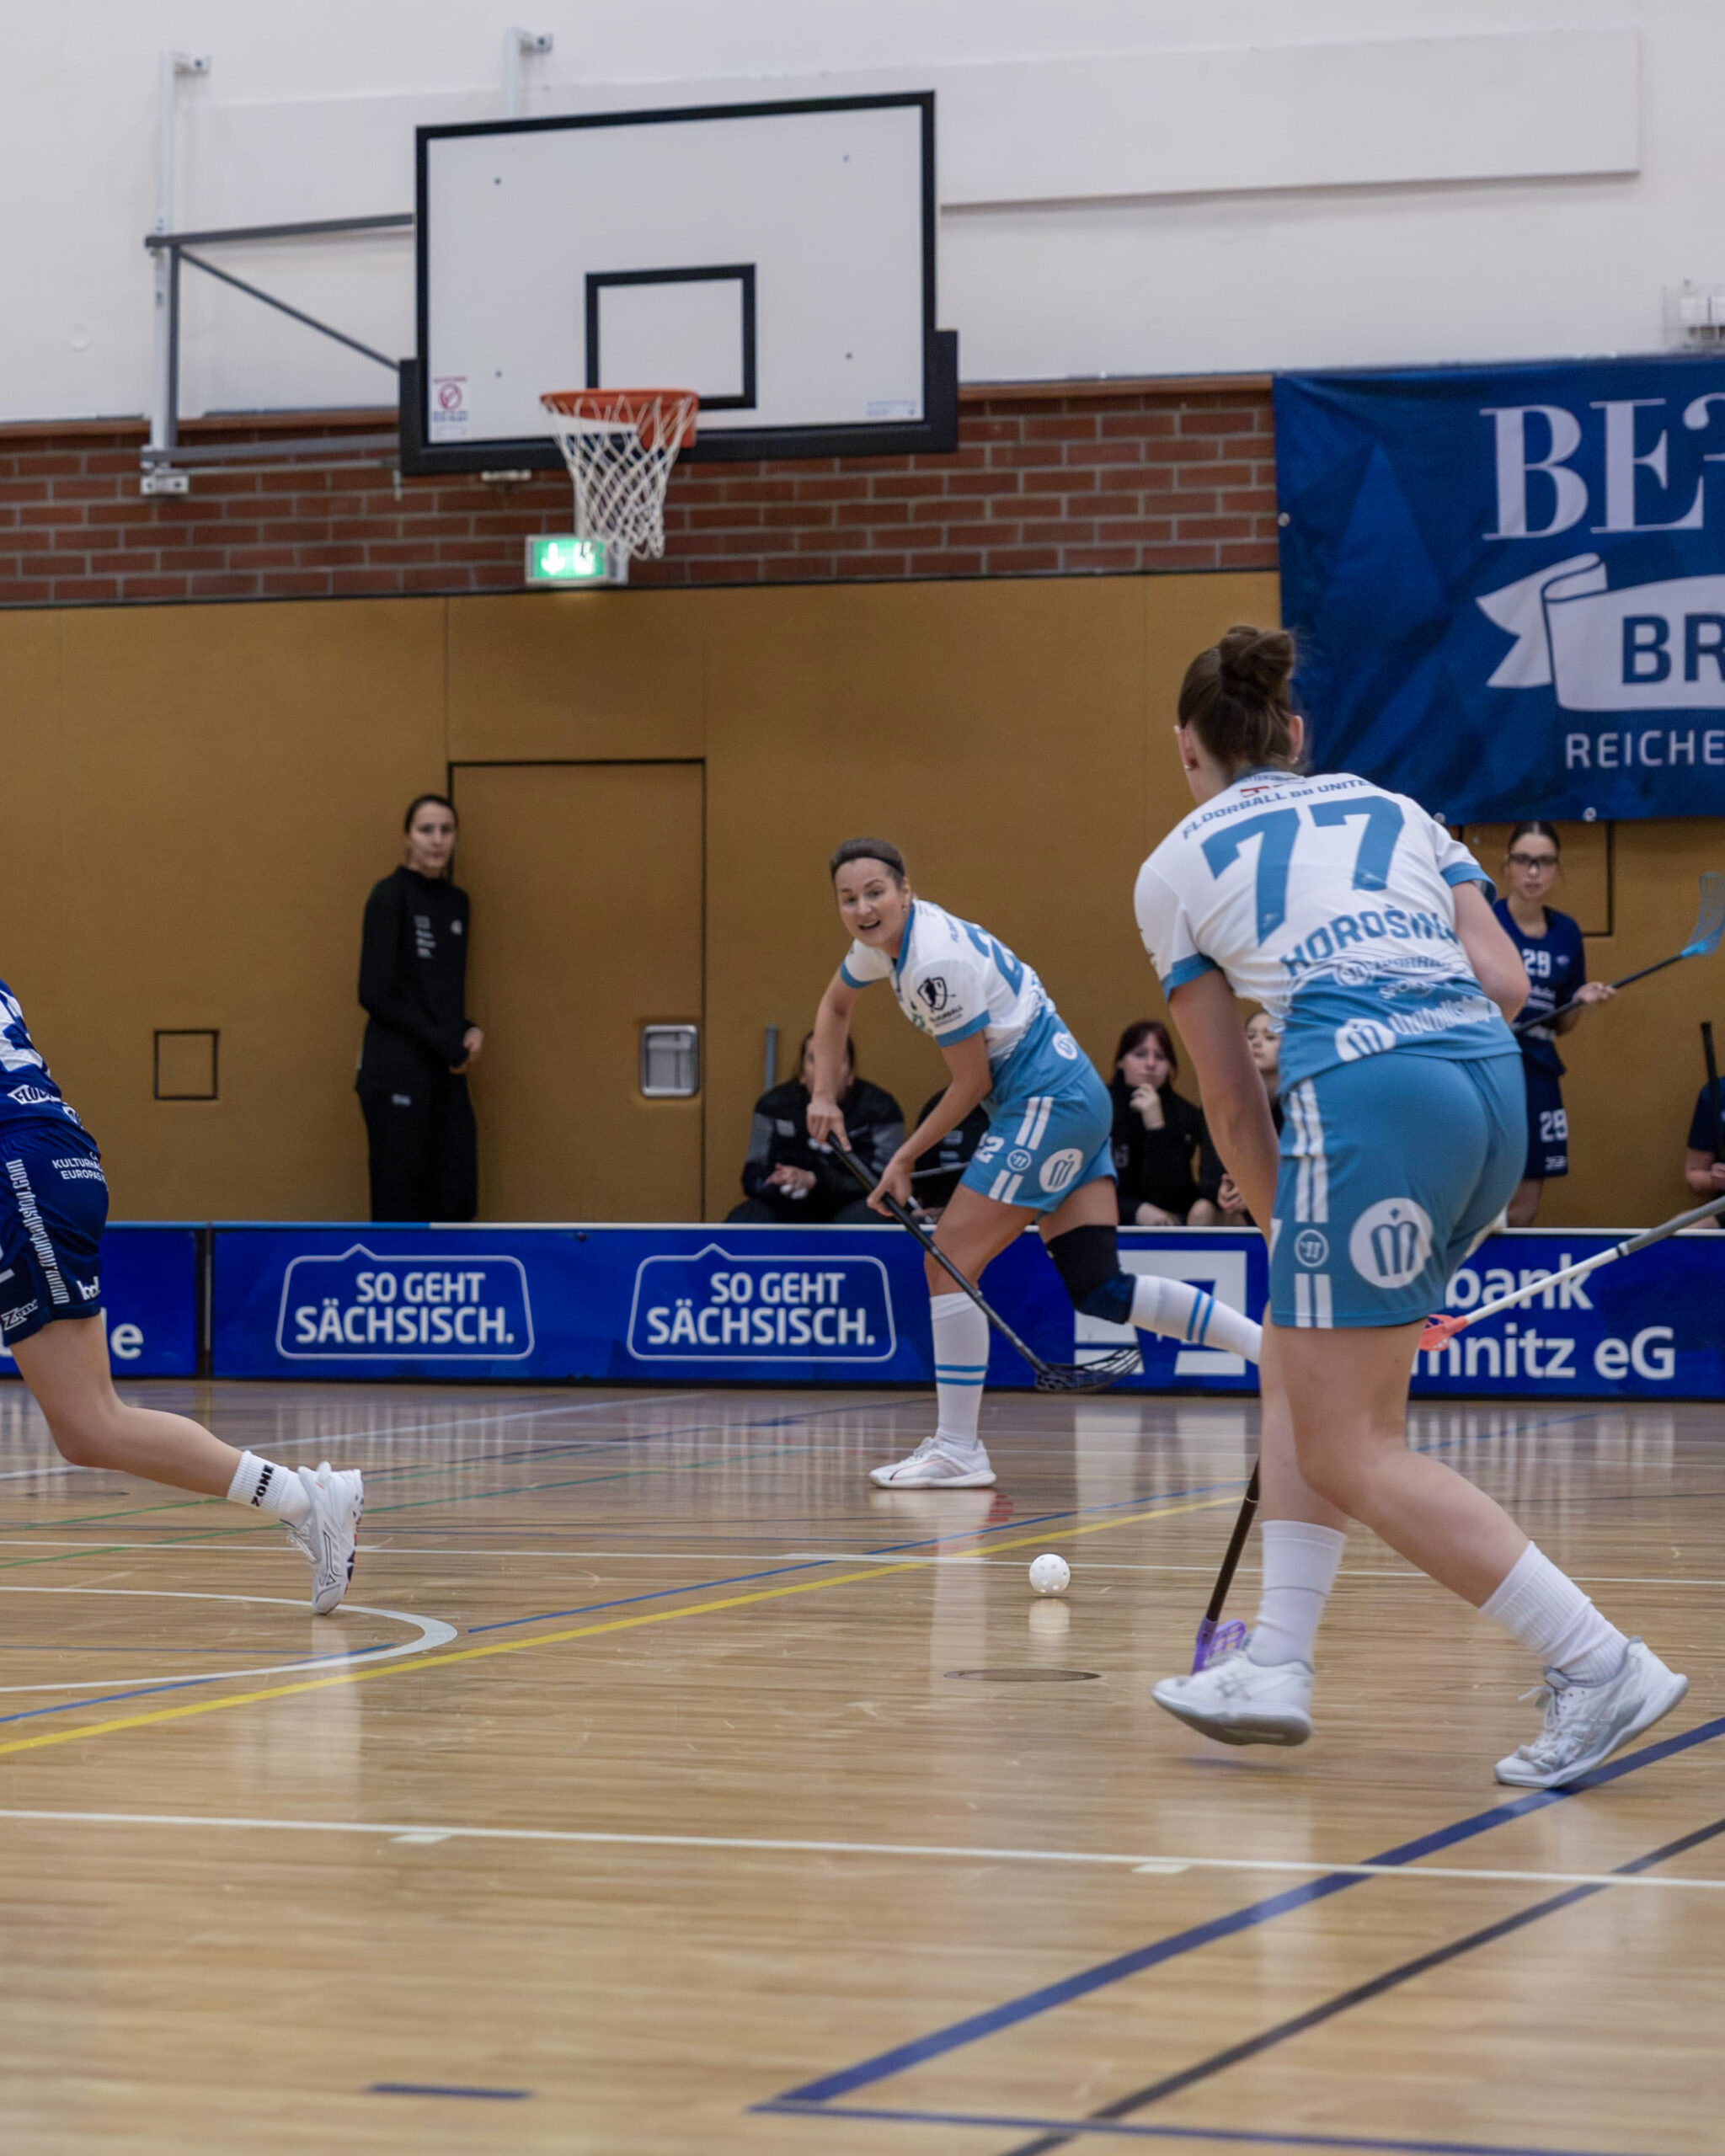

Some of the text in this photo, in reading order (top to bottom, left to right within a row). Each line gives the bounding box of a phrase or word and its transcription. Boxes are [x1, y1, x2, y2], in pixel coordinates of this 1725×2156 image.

[1480, 392, 1725, 540] BE
[1621, 612, 1725, 686] BR
[1565, 729, 1725, 770] REICHE
[1200, 795, 1405, 947] 77
[355, 1272, 486, 1303] SO GEHT
[710, 1272, 846, 1304] SO GEHT
[295, 1298, 515, 1344] SÄCHSISCH.
[646, 1298, 875, 1346] SÄCHSISCH.
[1594, 1326, 1675, 1380] eG
